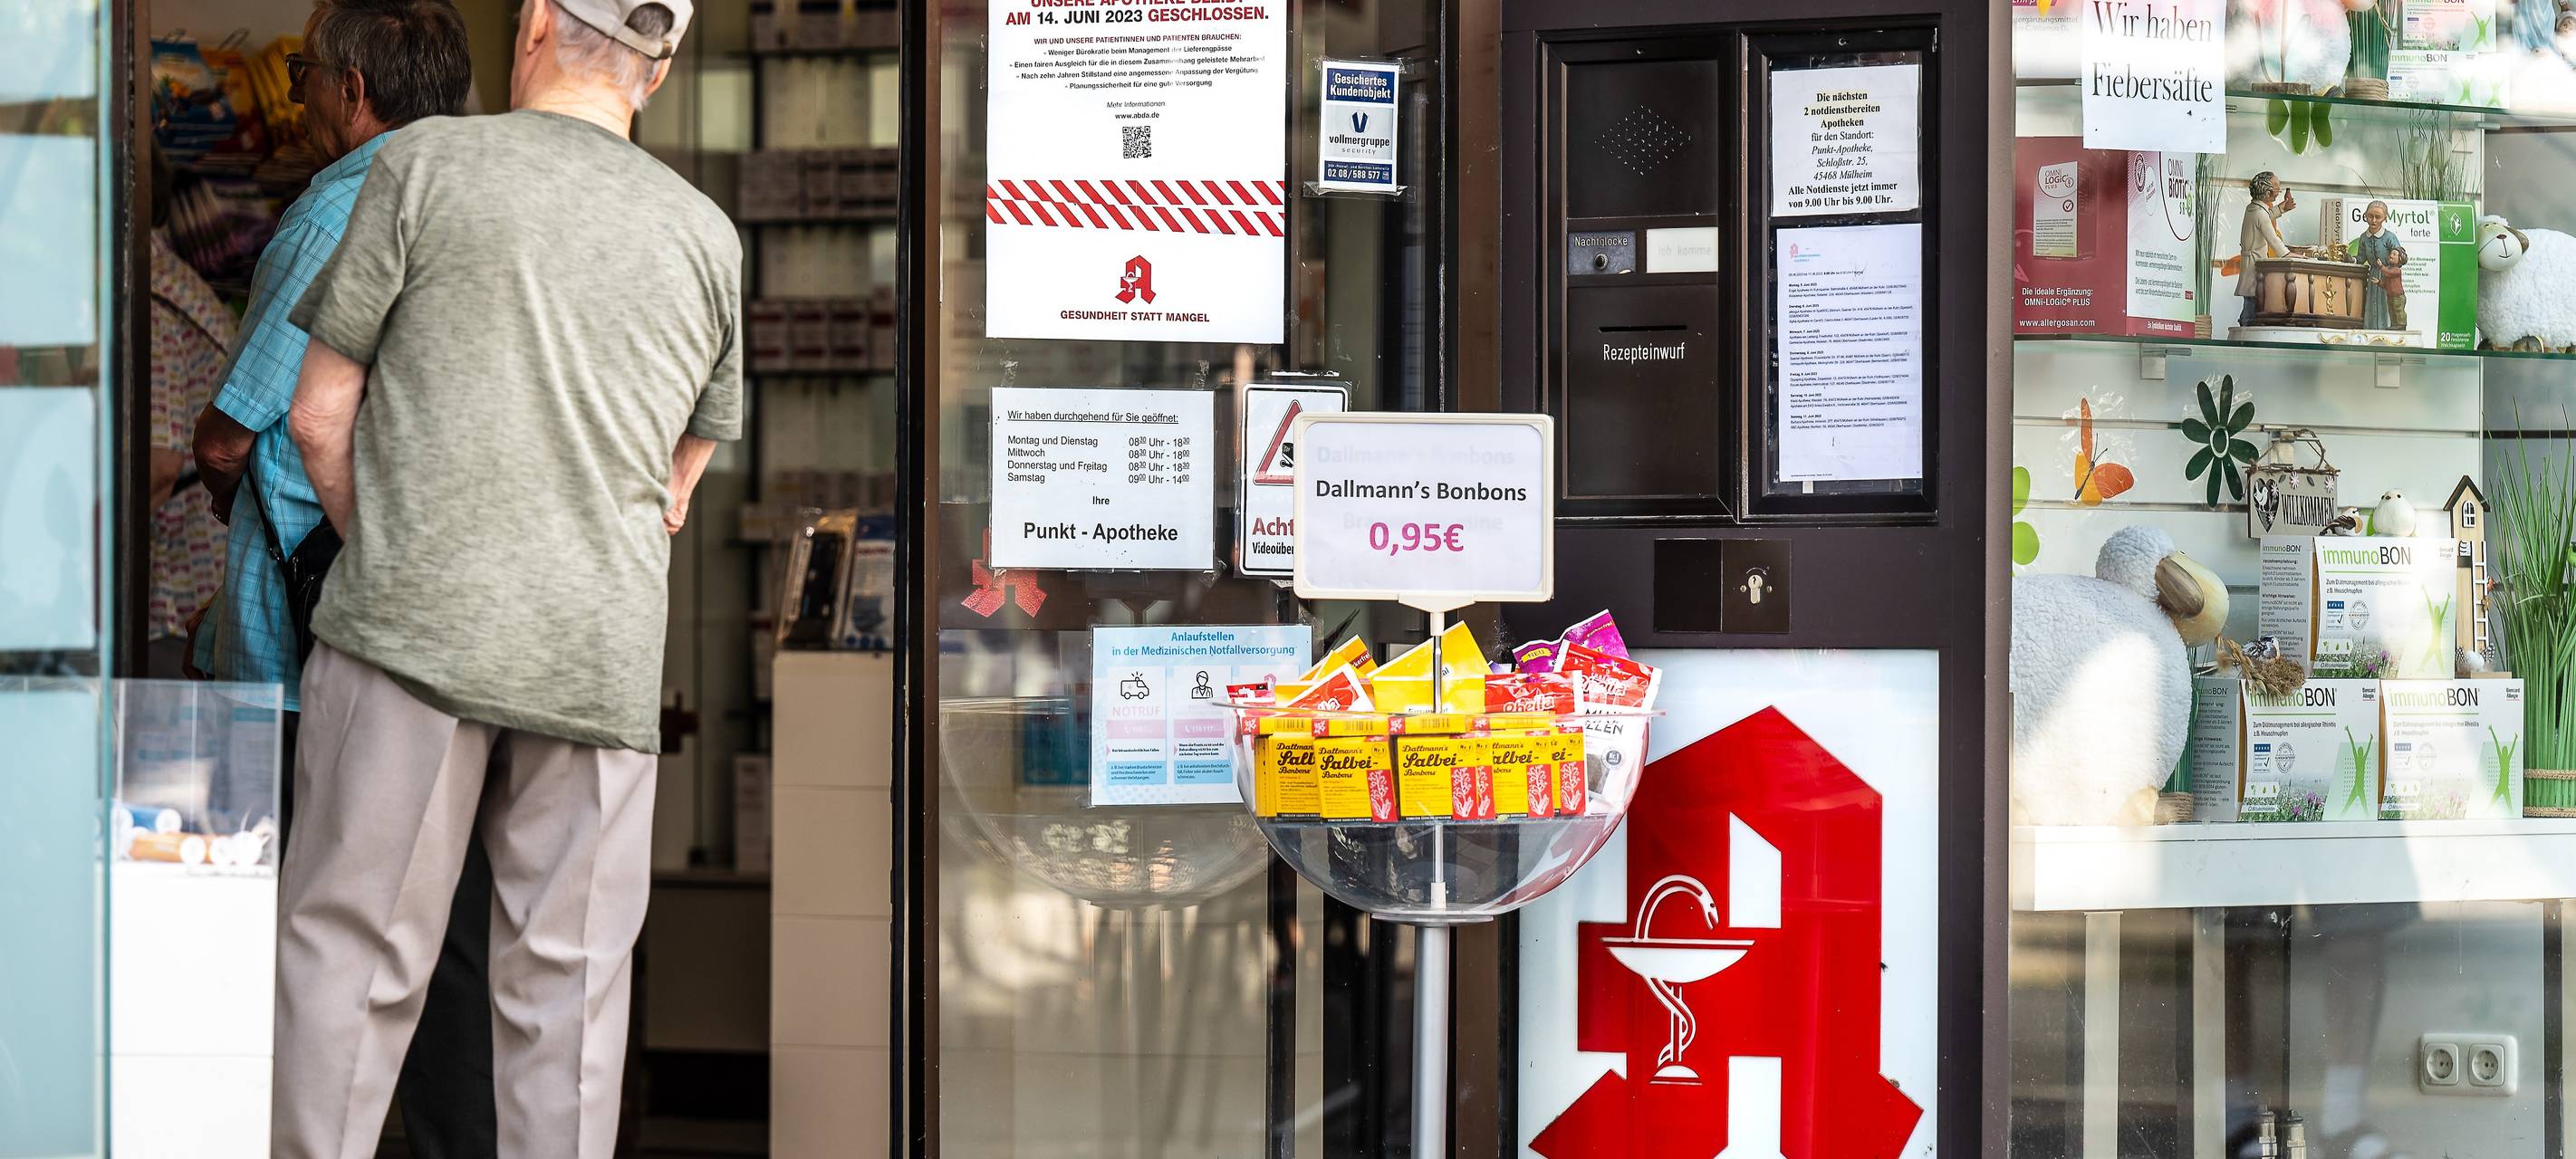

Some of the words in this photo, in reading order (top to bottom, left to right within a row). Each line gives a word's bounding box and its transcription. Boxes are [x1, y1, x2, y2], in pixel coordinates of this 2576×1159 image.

[1006, 12, 1030, 24] AM
[1037, 12, 1058, 24] 14.
[1064, 11, 1100, 24] JUNI
[1105, 10, 1142, 23] 2023
[1149, 7, 1268, 22] GESCHLOSSEN.
[2093, 1, 2139, 37] Wir
[2146, 4, 2212, 42] haben
[1184, 45, 1232, 53] Lieferengpässe
[1055, 60, 1087, 68] Ausgleich
[1129, 70, 1173, 78] angemessene
[1335, 73, 1387, 86] Gesichertes
[1070, 81, 1131, 90] Planungssicherheit
[2091, 62, 2213, 102] Fiebersäfte
[1331, 85, 1390, 100] Kundenobjekt
[1817, 92, 1831, 102] Die
[1832, 91, 1868, 101] nächsten
[1804, 108, 1809, 116] 2
[1812, 104, 1880, 115] notdienstbereiten
[1821, 119, 1864, 129] Apotheken
[1330, 134, 1389, 148] vollmergruppe
[1812, 133, 1821, 141] für
[1824, 132, 1838, 141] den
[1840, 131, 1873, 140] Standort:
[1812, 143, 1873, 155] Punkt-Apotheke,
[1817, 158, 1854, 170] Schloßstr.
[1857, 157, 1868, 167] 25,
[1328, 168, 1336, 177] 02
[1339, 168, 1366, 178] 08/588
[1368, 170, 1379, 179] 577
[1813, 171, 1837, 180] 45468
[1840, 170, 1872, 179] Mülheim
[1788, 187, 1804, 195] Alle
[1806, 185, 1849, 195] Notdienste
[1850, 184, 1869, 196] jetzt
[1871, 183, 1898, 191] immer
[1805, 198, 1821, 207] 9.00
[1824, 197, 1840, 206] Uhr
[1842, 196, 1853, 206] bis
[1856, 196, 1872, 205] 9.00
[1875, 195, 1893, 204] Uhr.
[2410, 228, 2431, 237] forte
[1574, 236, 1628, 246] Nachtglocke
[2035, 287, 2054, 295] ideale
[2057, 288, 2093, 297] Ergänzung:
[1061, 311, 1128, 321] GESUNDHEIT
[1131, 311, 1162, 321] STATT
[1166, 312, 1210, 322] MANGEL
[2020, 319, 2095, 328] www.allergosan.com
[2440, 332, 2450, 342] 20
[1603, 342, 1685, 365] Rezepteinwurf
[1008, 410, 1023, 420] Wir
[1025, 411, 1052, 420] haben
[1054, 412, 1109, 422] durchgehend
[1111, 412, 1124, 421] für
[1127, 413, 1139, 422] Sie
[1142, 413, 1178, 423] geöffnet:
[1008, 436, 1039, 446] Montag
[1043, 436, 1058, 445] und
[1061, 436, 1098, 447] Dienstag
[1149, 438, 1164, 446] Uhr
[1008, 448, 1045, 457] Mittwoch
[1149, 450, 1164, 459] Uhr
[1008, 461, 1056, 470] Donnerstag
[1060, 462, 1075, 470] und
[1078, 462, 1107, 472] Freitag
[1149, 463, 1164, 472] Uhr
[1008, 474, 1045, 484] Samstag
[1149, 475, 1164, 484] Uhr
[1437, 482, 1527, 502] Bonbons
[1092, 496, 1110, 505] Ihre
[2281, 493, 2335, 527] WILLKOMMEN
[1253, 517, 1293, 536] Acht
[1024, 522, 1076, 539] Punkt
[1092, 523, 1178, 543] Apotheke
[1369, 522, 1465, 557] 0,95€
[2322, 545, 2411, 565] immunoBON
[1171, 632, 1235, 642] Anlaufstellen
[1112, 647, 1120, 656] in
[1123, 646, 1139, 656] der
[1141, 645, 1206, 656] Medizinischen
[1209, 645, 1295, 657] Notfallversorgung
[1321, 756, 1378, 770] Salbei-
[1403, 752, 1463, 768] Salbei-
[1404, 768, 1436, 776] Bonbons
